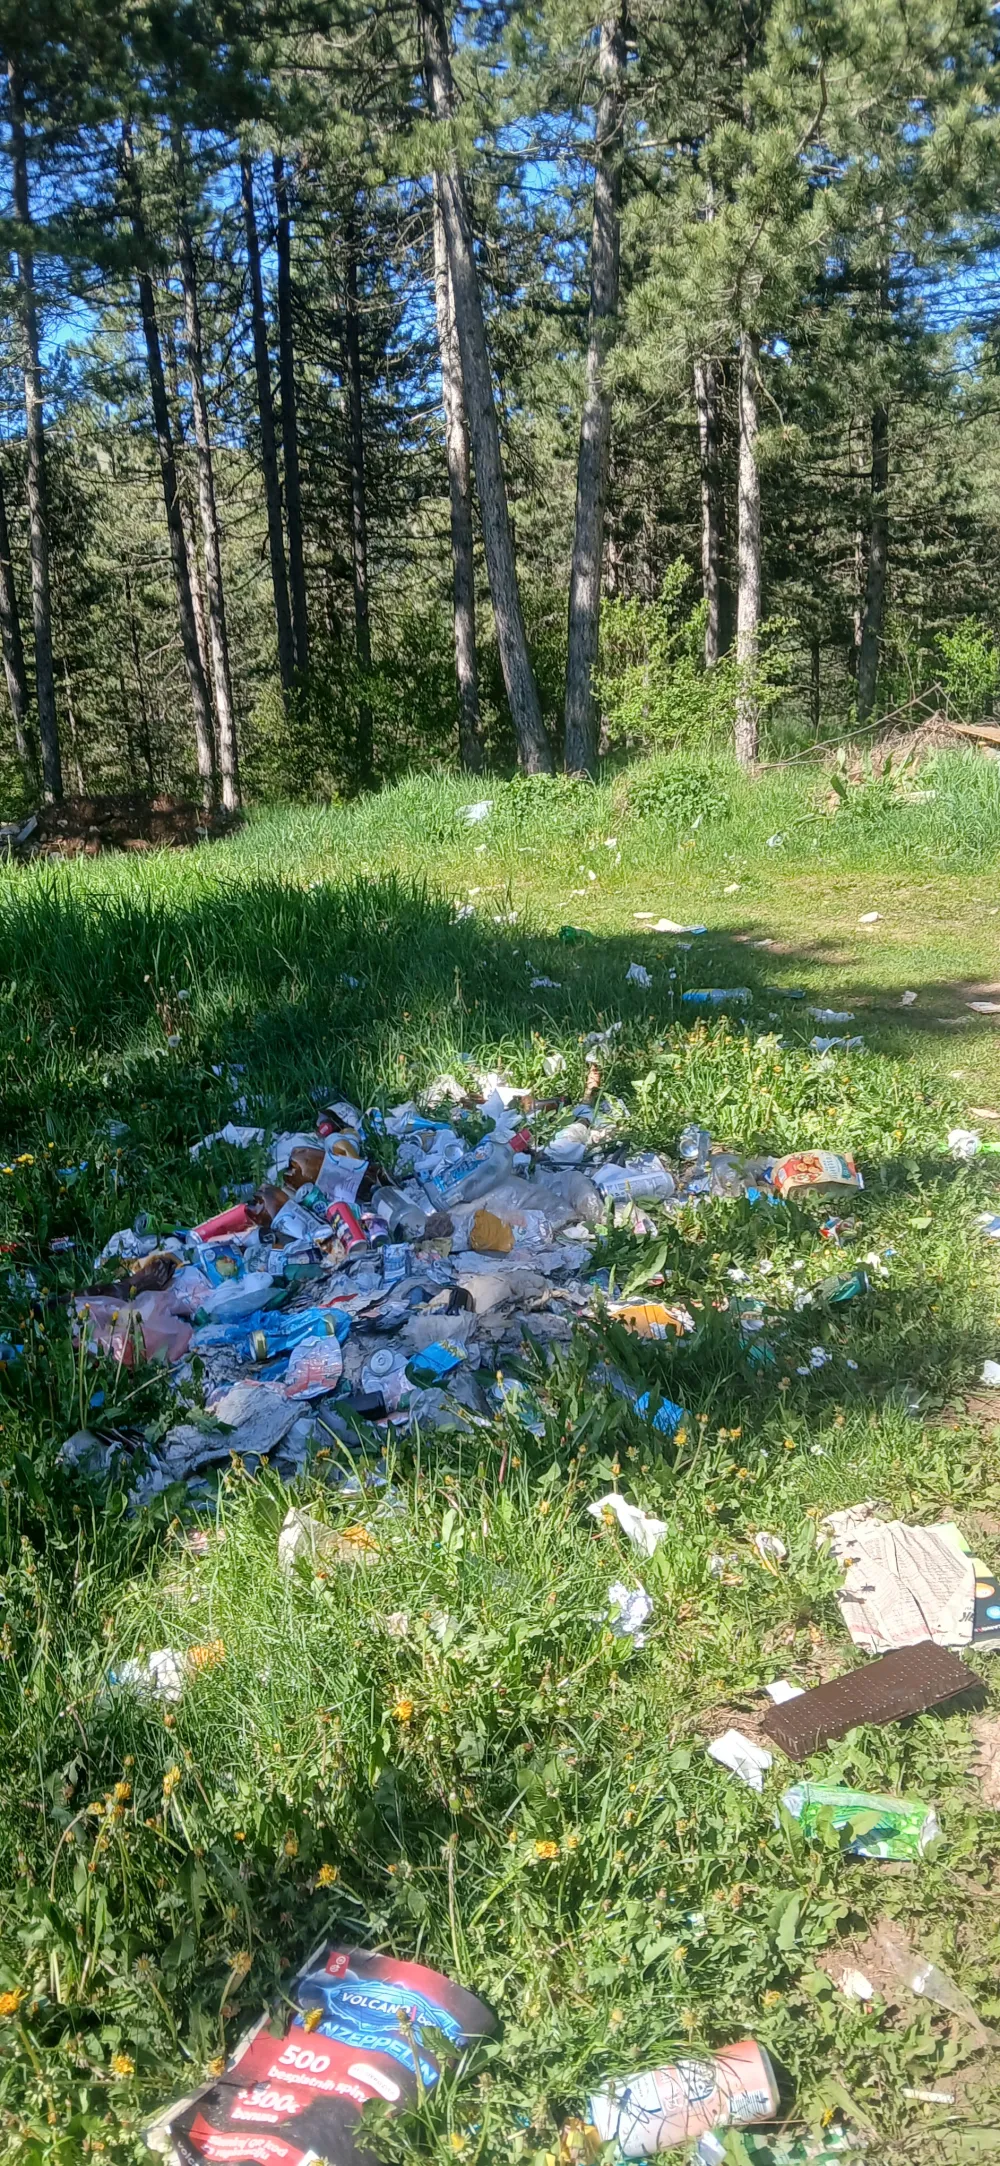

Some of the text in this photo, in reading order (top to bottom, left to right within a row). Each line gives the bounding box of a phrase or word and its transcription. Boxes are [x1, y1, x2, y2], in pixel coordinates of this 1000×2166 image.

[342, 1992, 412, 2018] VOLCANO
[278, 2044, 331, 2073] 500
[267, 2065, 335, 2092] besplatnih
